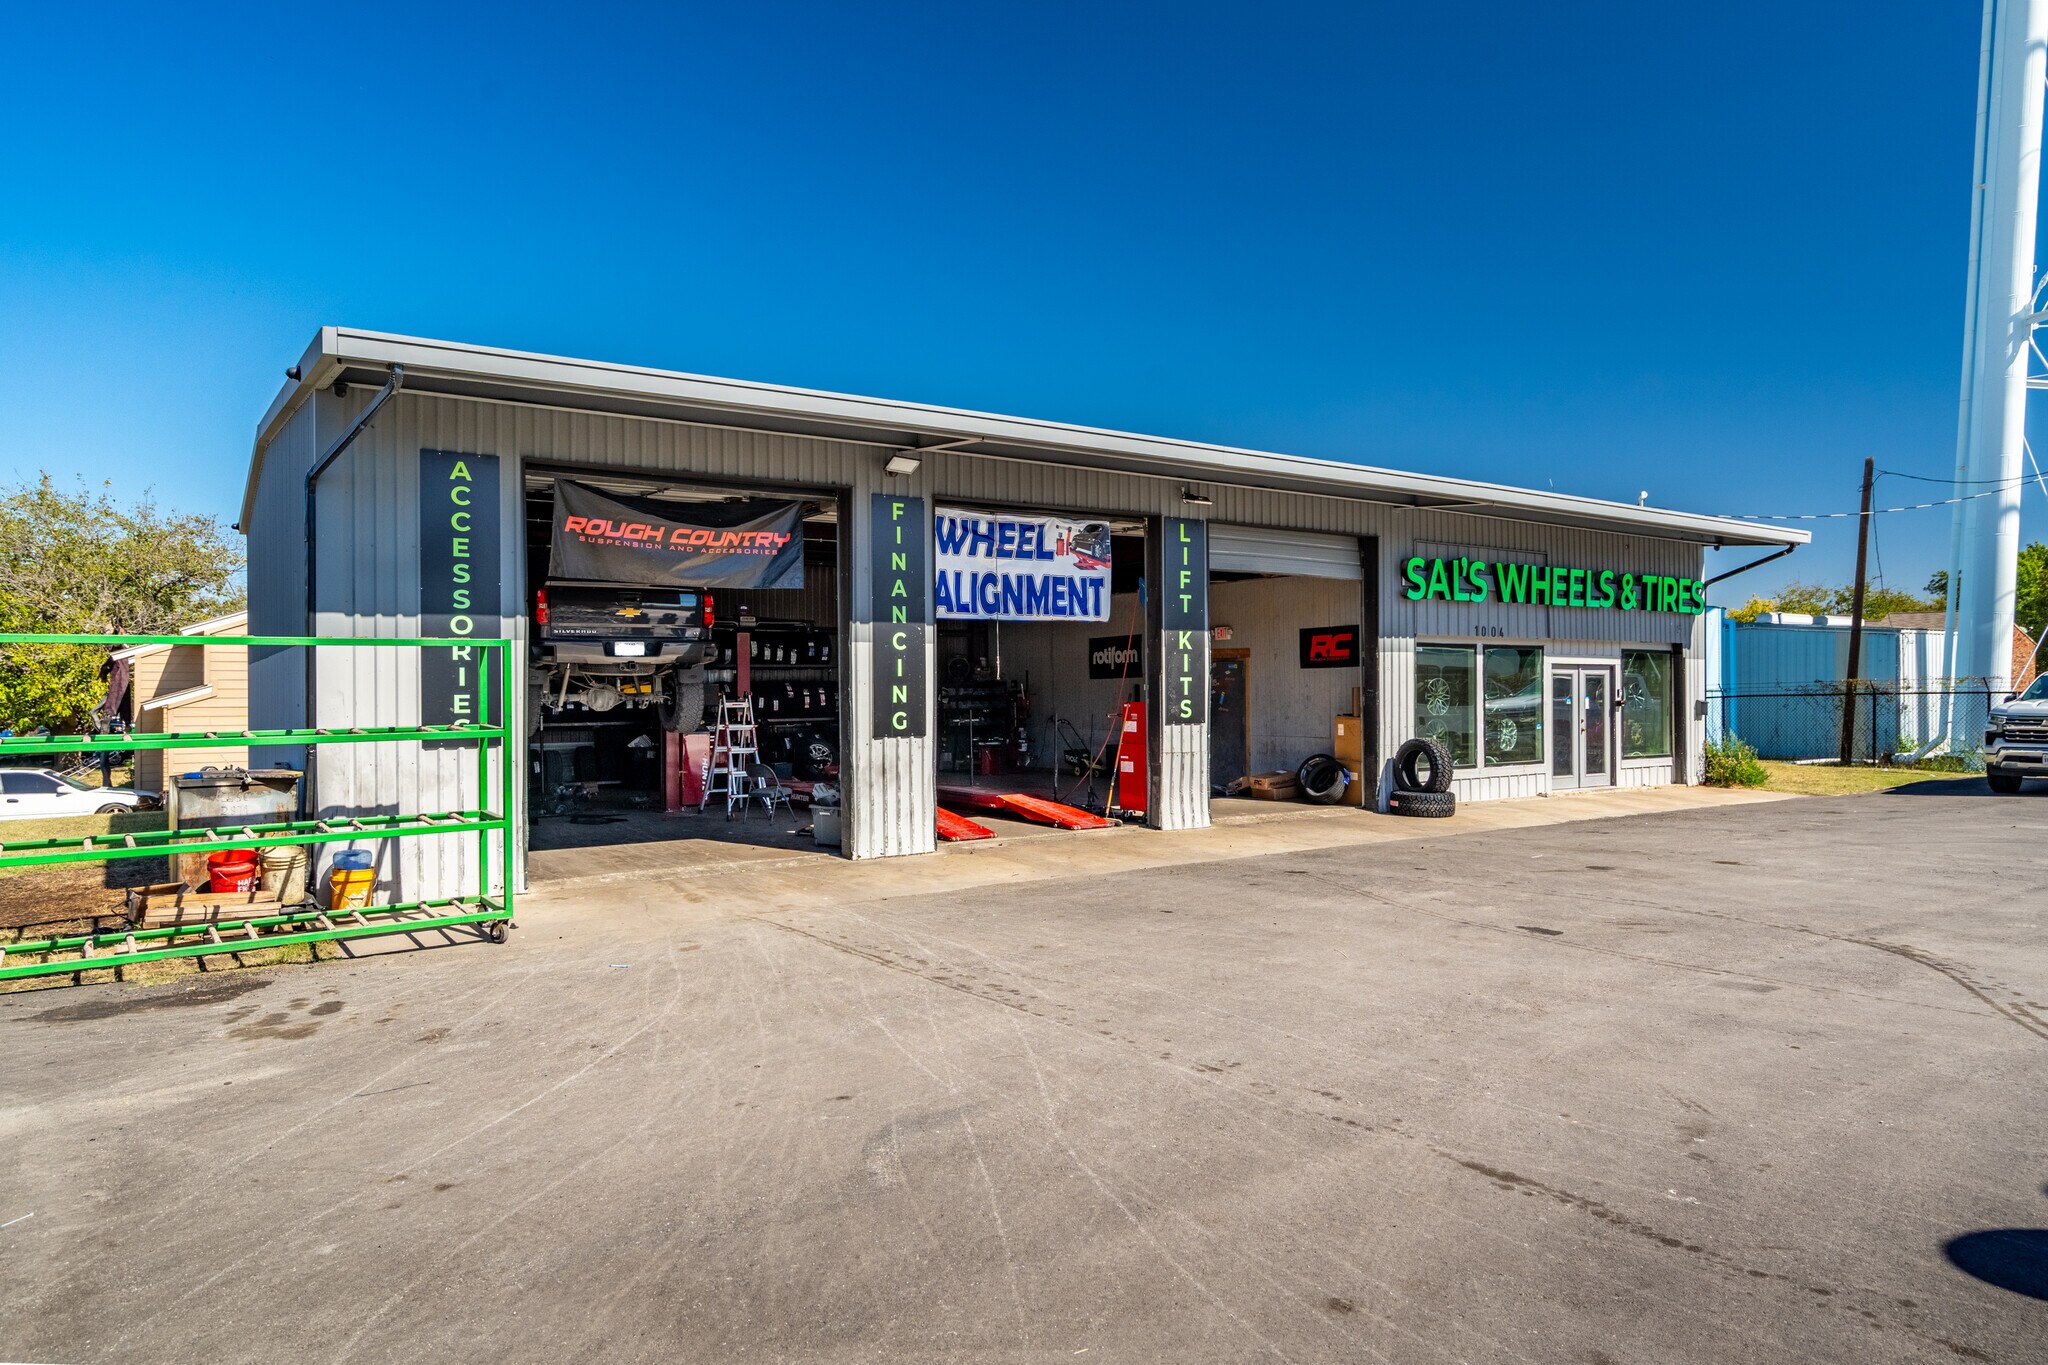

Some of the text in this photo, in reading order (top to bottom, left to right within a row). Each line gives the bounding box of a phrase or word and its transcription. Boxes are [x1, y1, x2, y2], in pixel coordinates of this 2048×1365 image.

[564, 516, 791, 548] ROUGH COUNTRY
[579, 535, 778, 556] SUSPENSION AND ACCESSORIES
[935, 514, 1055, 561] WHEEL
[935, 569, 1106, 617] ALIGNMENT
[1404, 556, 1705, 616] SAL'S WHEELS & TIRES
[891, 502, 907, 730] FINANCING
[1178, 523, 1193, 719] LIFT KITS
[1474, 625, 1504, 638] 1004
[1092, 646, 1139, 670] rotiform
[1310, 633, 1353, 657] RC
